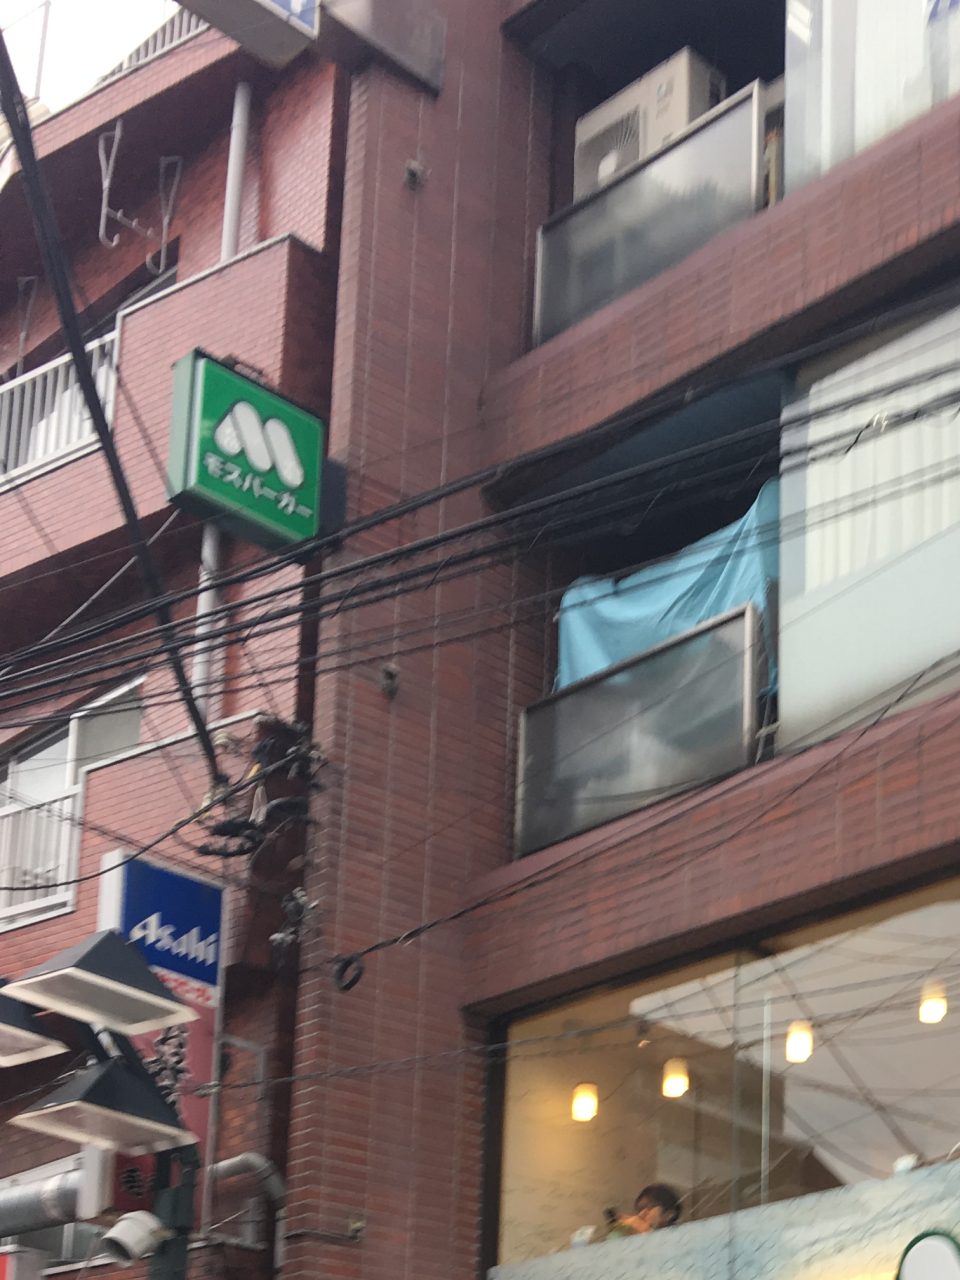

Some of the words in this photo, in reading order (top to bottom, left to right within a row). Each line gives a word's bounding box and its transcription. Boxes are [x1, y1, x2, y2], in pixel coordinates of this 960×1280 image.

[203, 452, 312, 519] モスバーガー
[125, 911, 219, 967] Asahi
